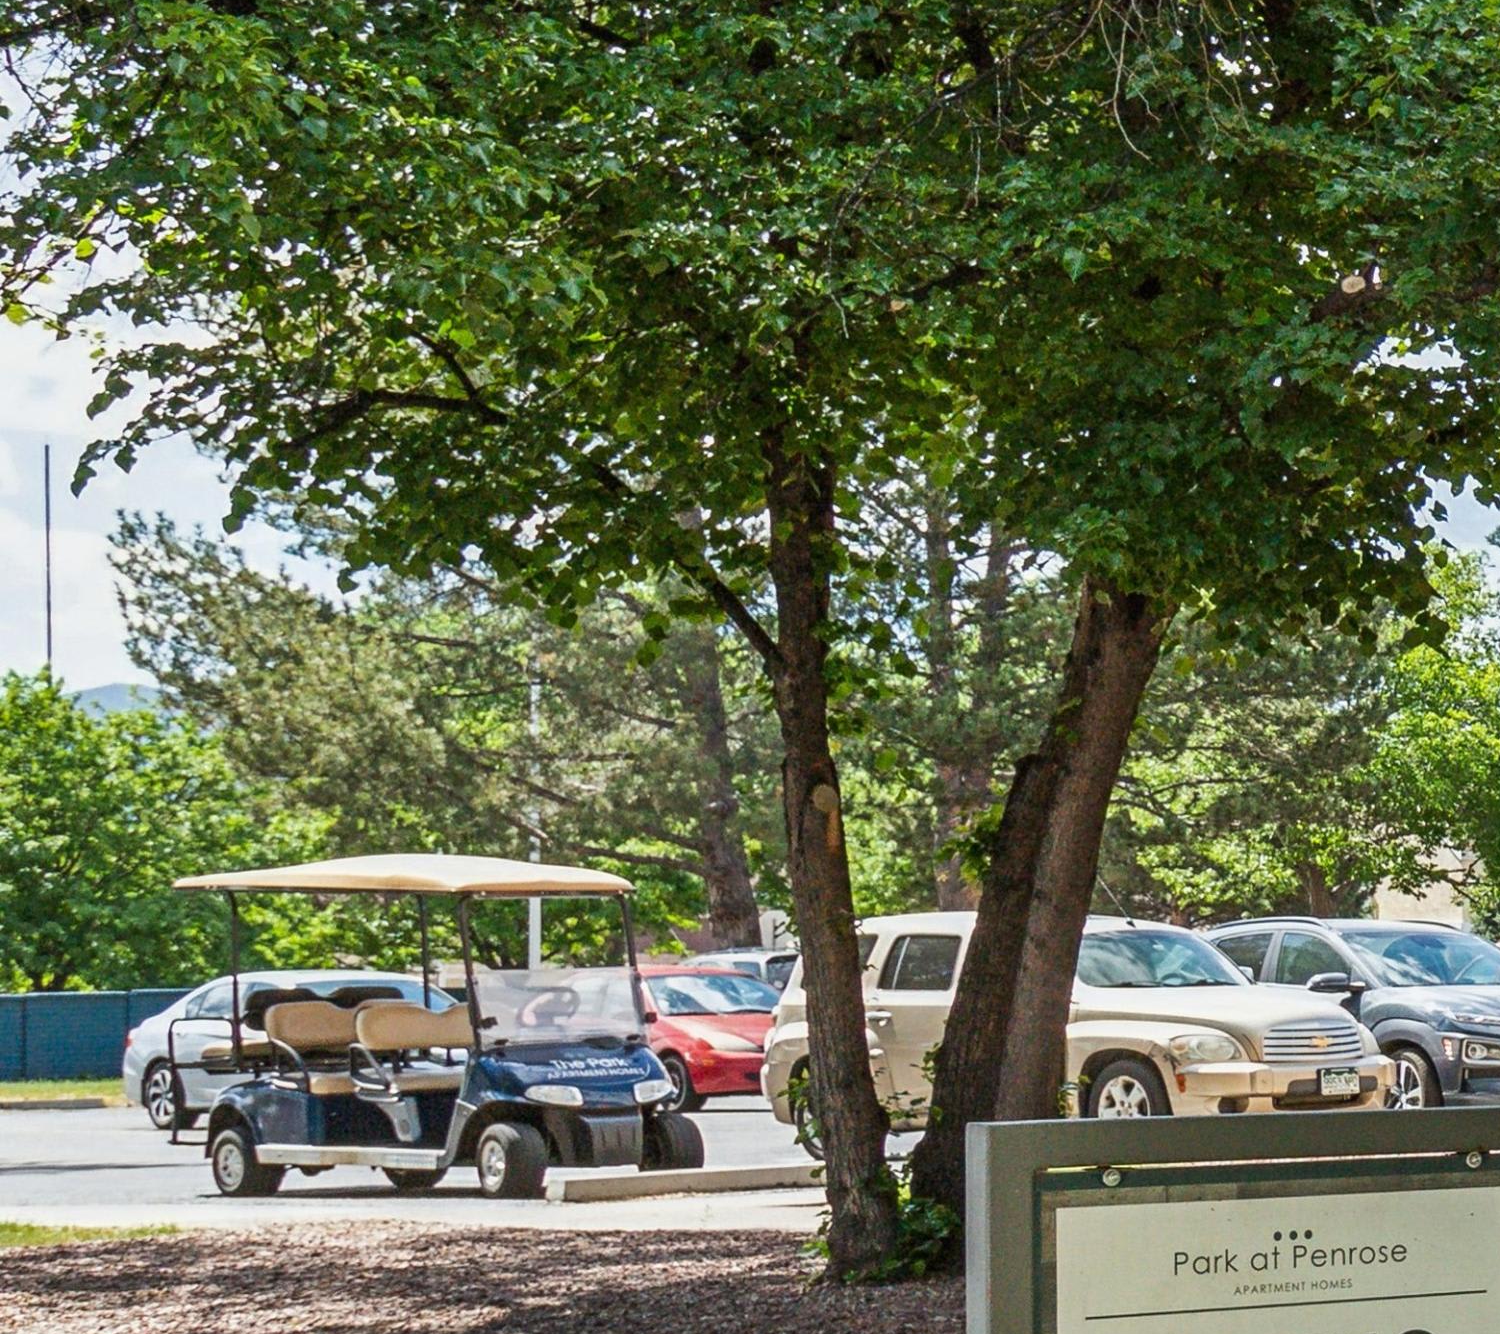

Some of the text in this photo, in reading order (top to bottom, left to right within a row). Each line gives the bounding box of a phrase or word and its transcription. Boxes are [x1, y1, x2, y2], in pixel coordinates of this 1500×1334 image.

[549, 1057, 629, 1070] The Park
[1173, 1243, 1408, 1276] Park at Penrose
[1233, 1278, 1353, 1296] APARTMENT HOMES
